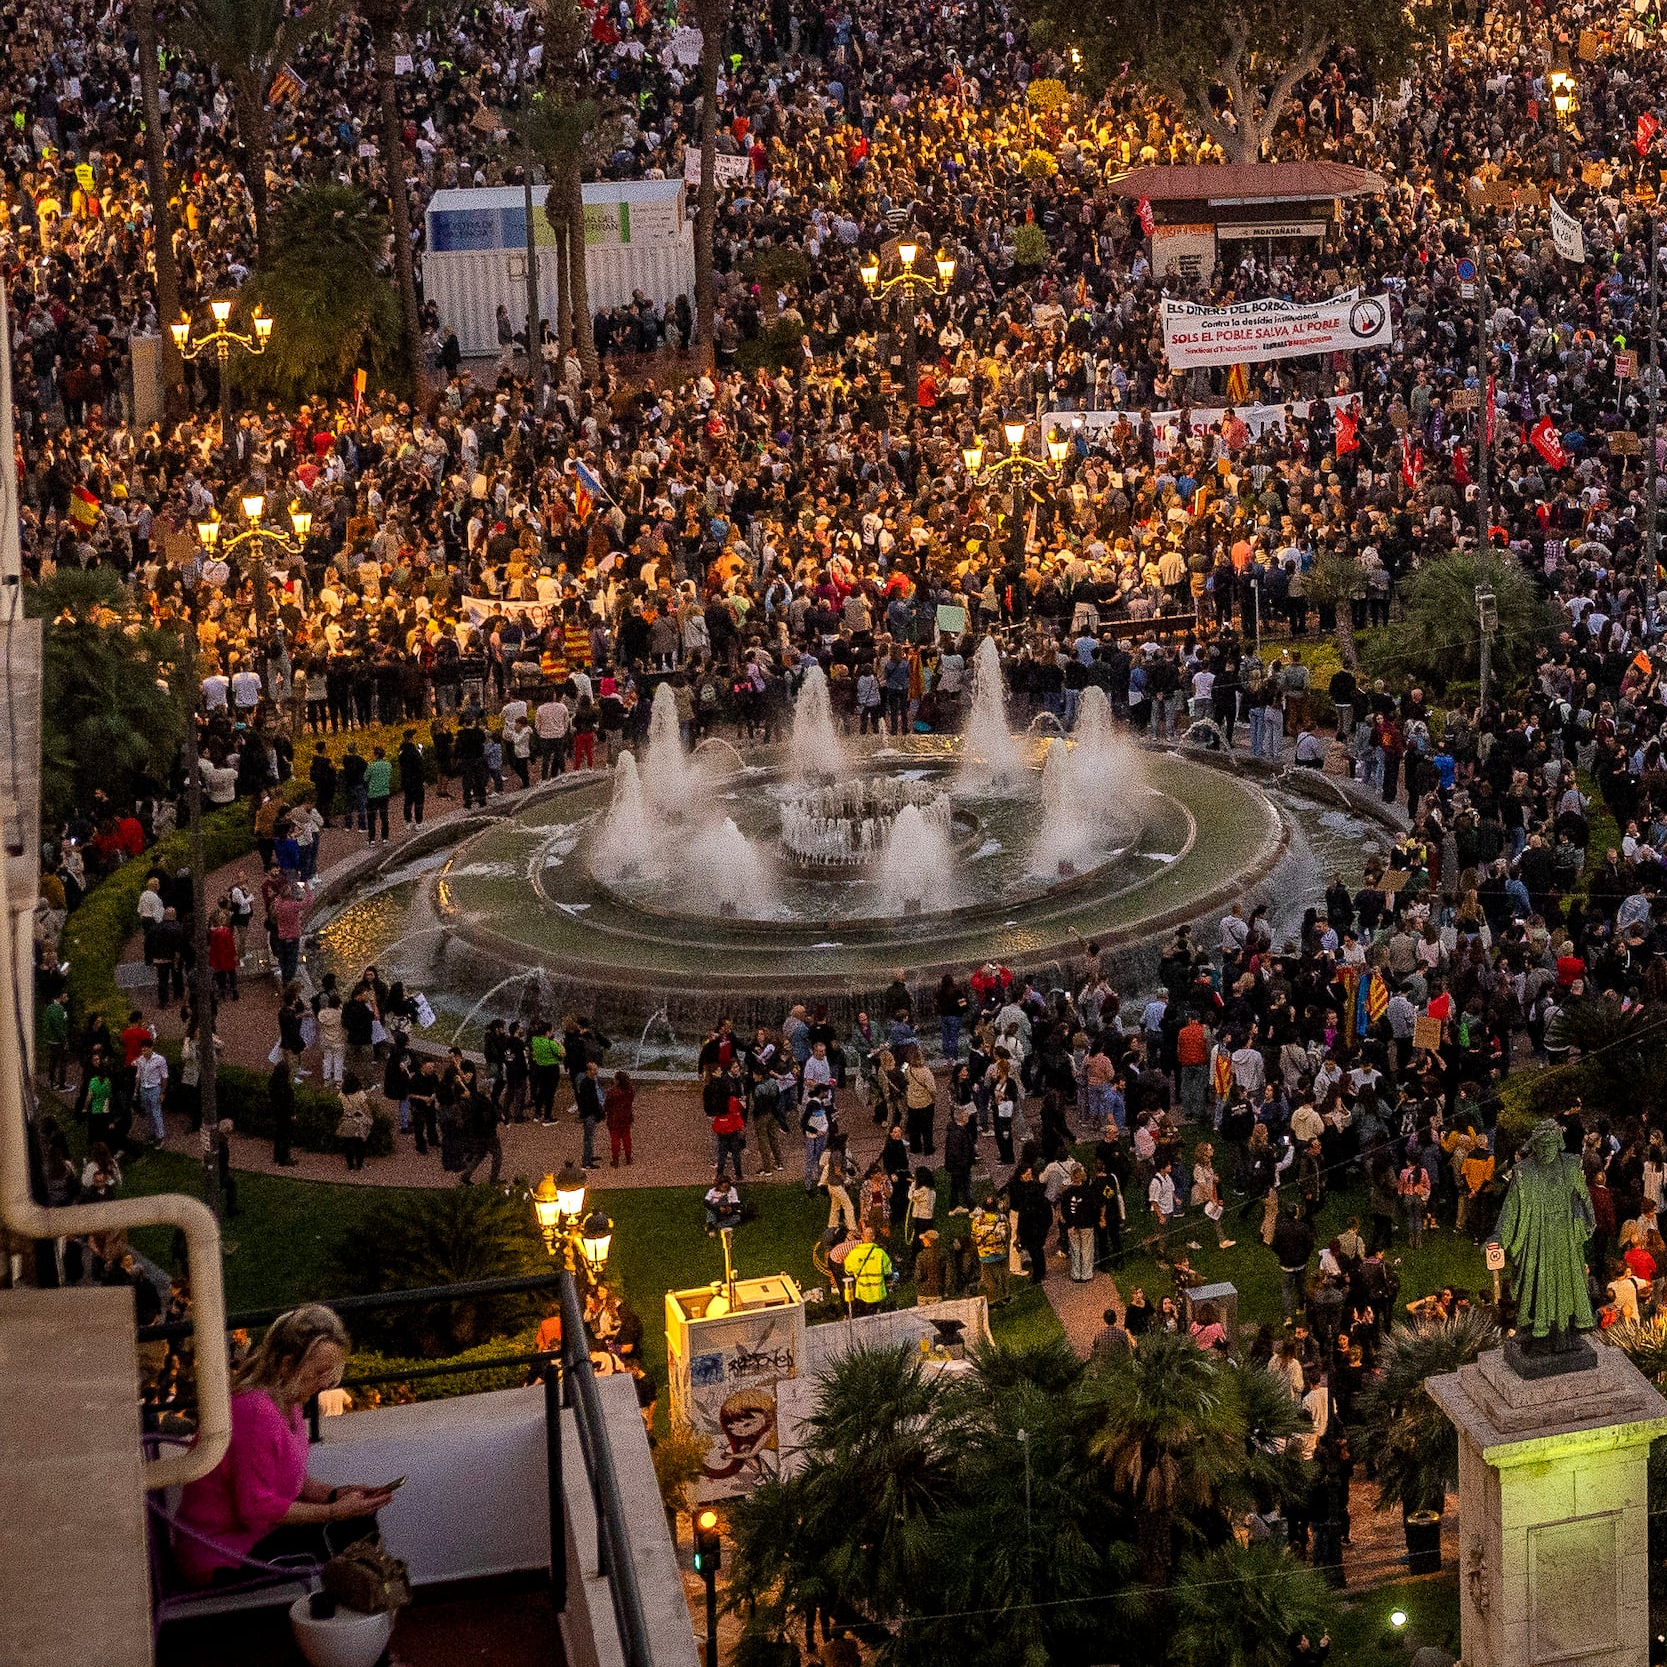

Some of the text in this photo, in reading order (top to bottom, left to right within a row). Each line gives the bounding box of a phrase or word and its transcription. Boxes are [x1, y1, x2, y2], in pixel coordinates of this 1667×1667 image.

[1253, 226, 1301, 236] MONTAÑANA
[1167, 304, 1184, 314] ELS
[1187, 305, 1227, 316] DINERS
[1230, 304, 1250, 314] DEL
[1201, 311, 1319, 328] Contra la desídia institucional
[1172, 318, 1341, 345] SOLS EL POBLE SALVA AL POBLE
